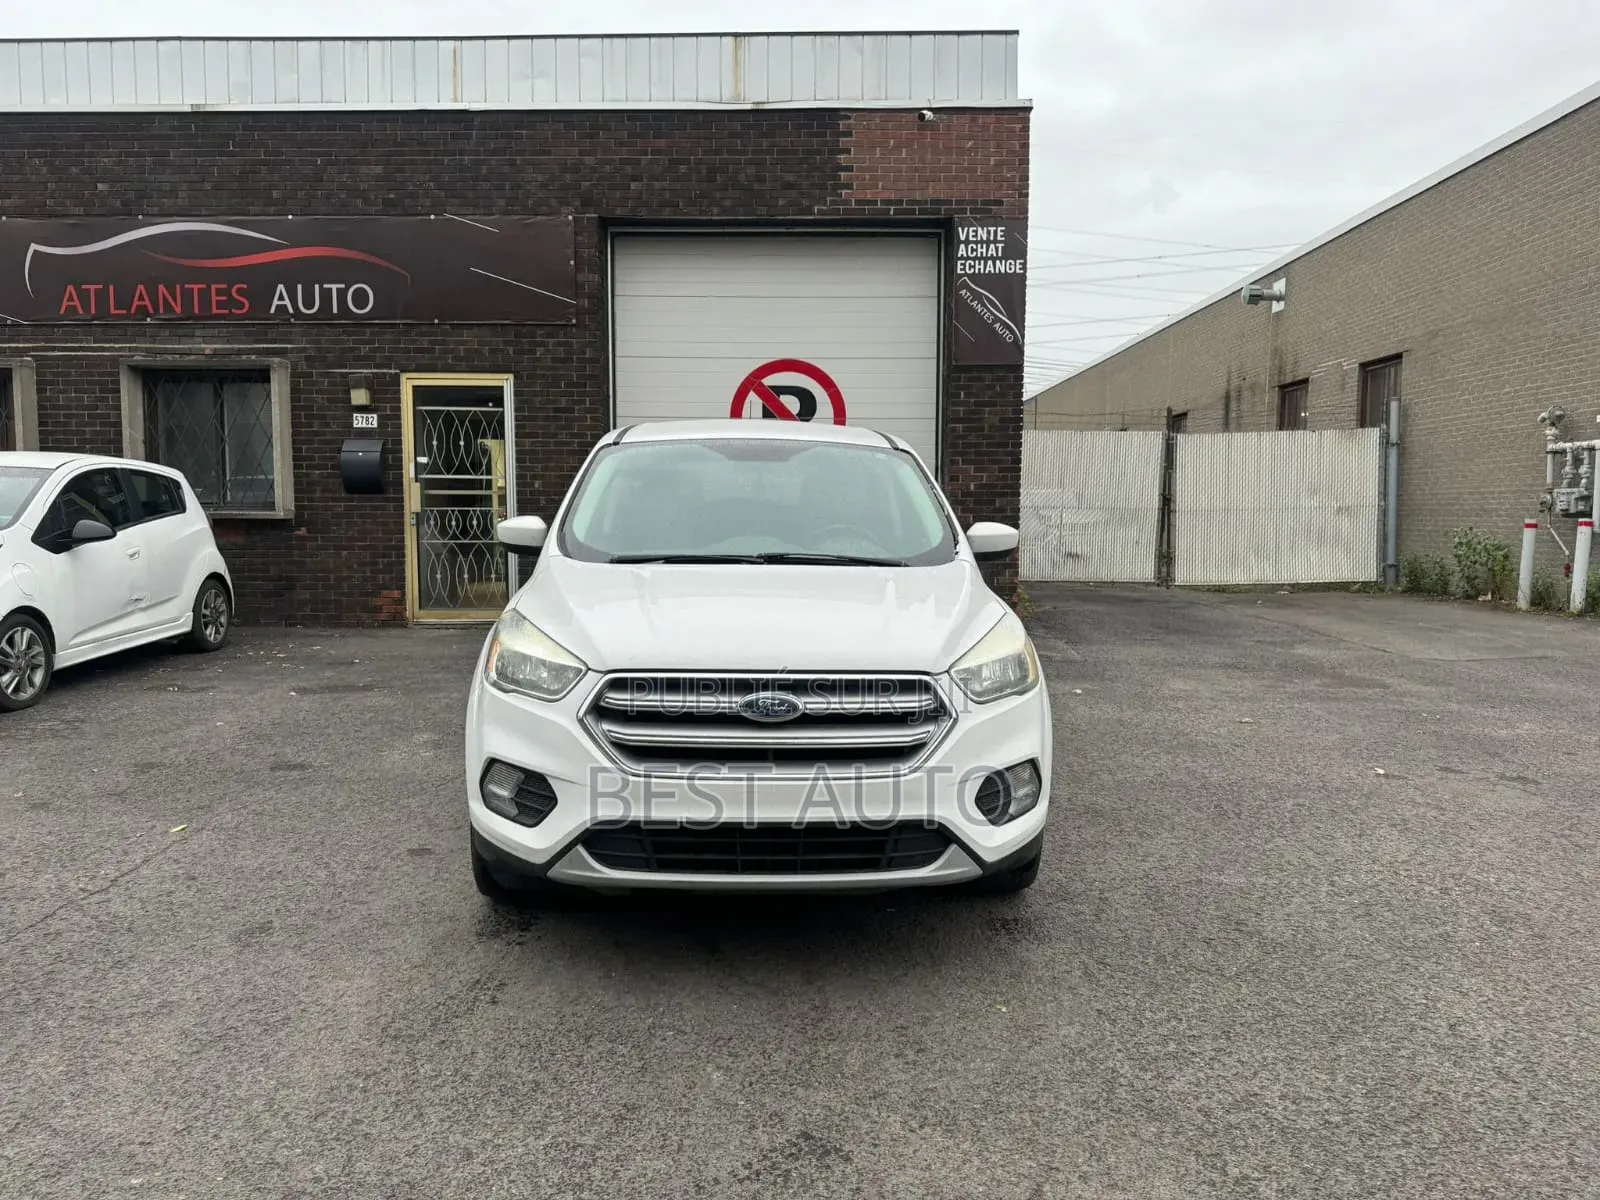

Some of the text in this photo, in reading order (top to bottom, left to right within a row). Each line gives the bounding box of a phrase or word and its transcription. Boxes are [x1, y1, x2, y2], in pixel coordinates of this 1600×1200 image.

[958, 227, 1006, 241] VENTE
[957, 243, 1005, 257] ACHAT
[957, 259, 1024, 274] ECHANGE
[60, 283, 375, 315] ATLANTES AUTO
[959, 289, 1014, 343] ATLANTES AUTO
[354, 415, 375, 426] 5782
